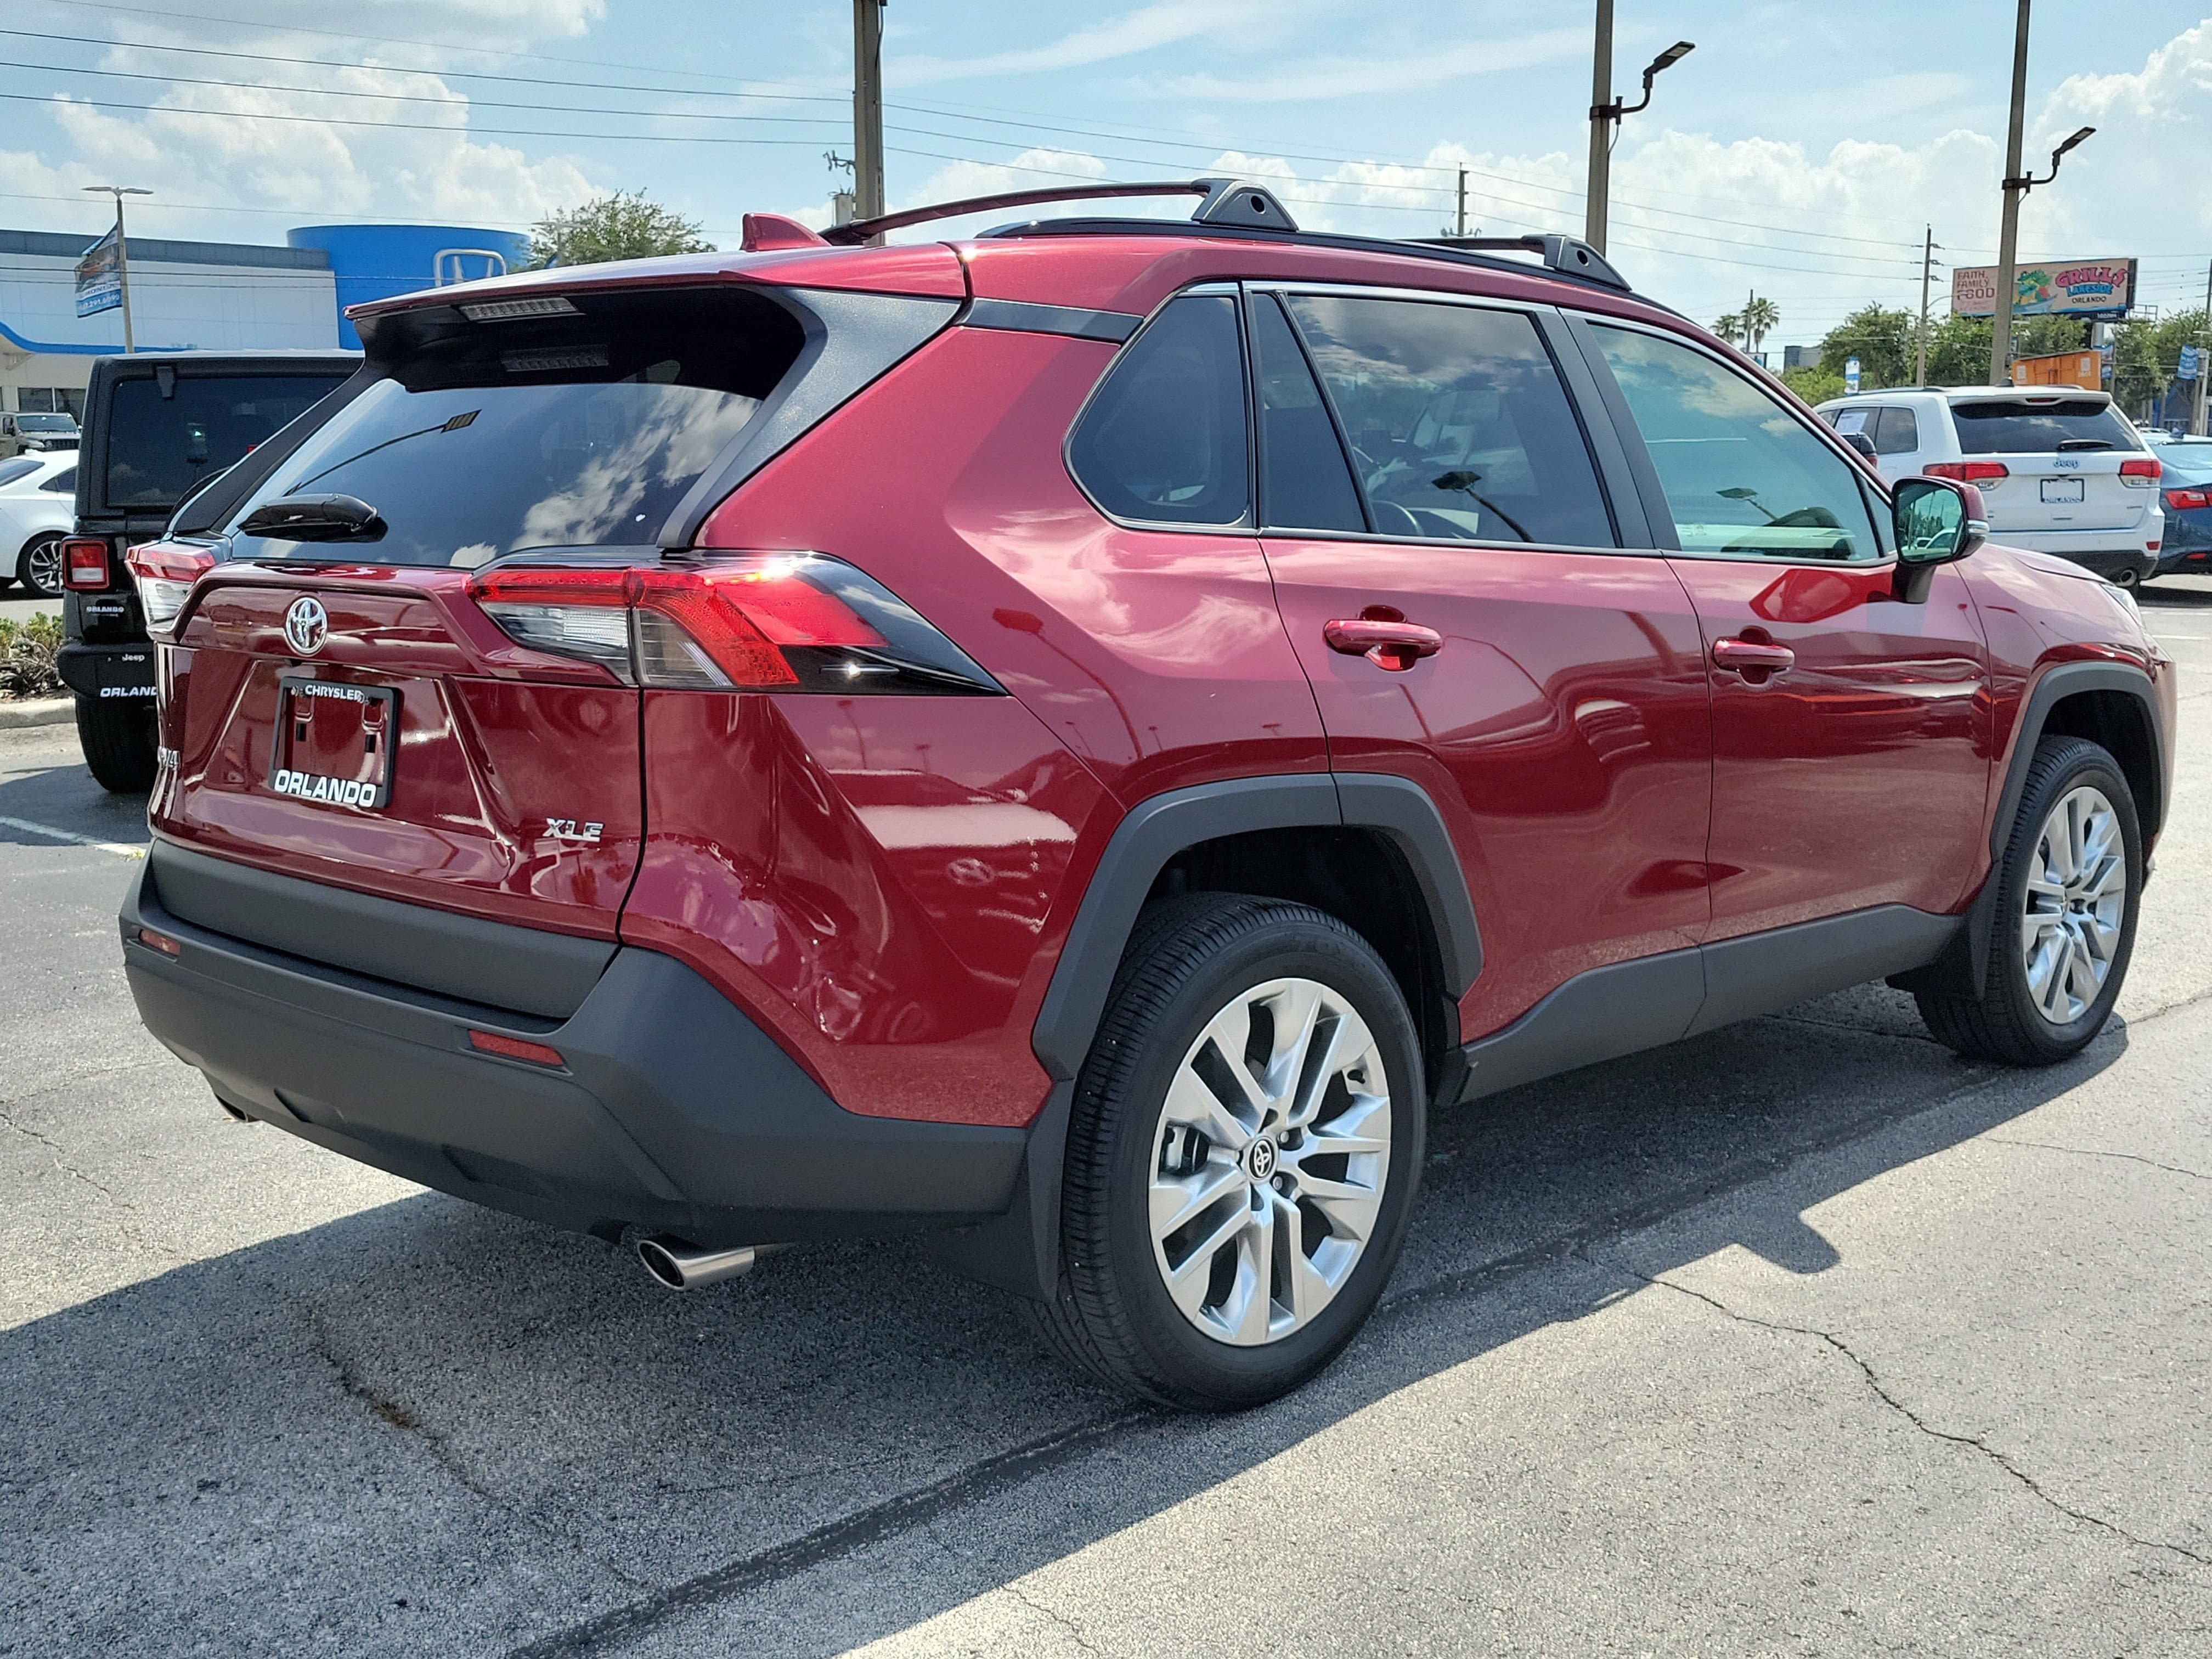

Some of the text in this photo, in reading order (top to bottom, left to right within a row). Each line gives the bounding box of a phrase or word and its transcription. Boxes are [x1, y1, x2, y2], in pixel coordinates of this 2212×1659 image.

[2055, 267, 2128, 287] GRILLS
[1957, 288, 1995, 300] FOOD
[2053, 457, 2079, 469] Jeep
[122, 653, 145, 662] Jeep
[100, 686, 157, 697] ORLAND
[274, 769, 377, 808] ORLANDO
[542, 817, 604, 843] XLE
